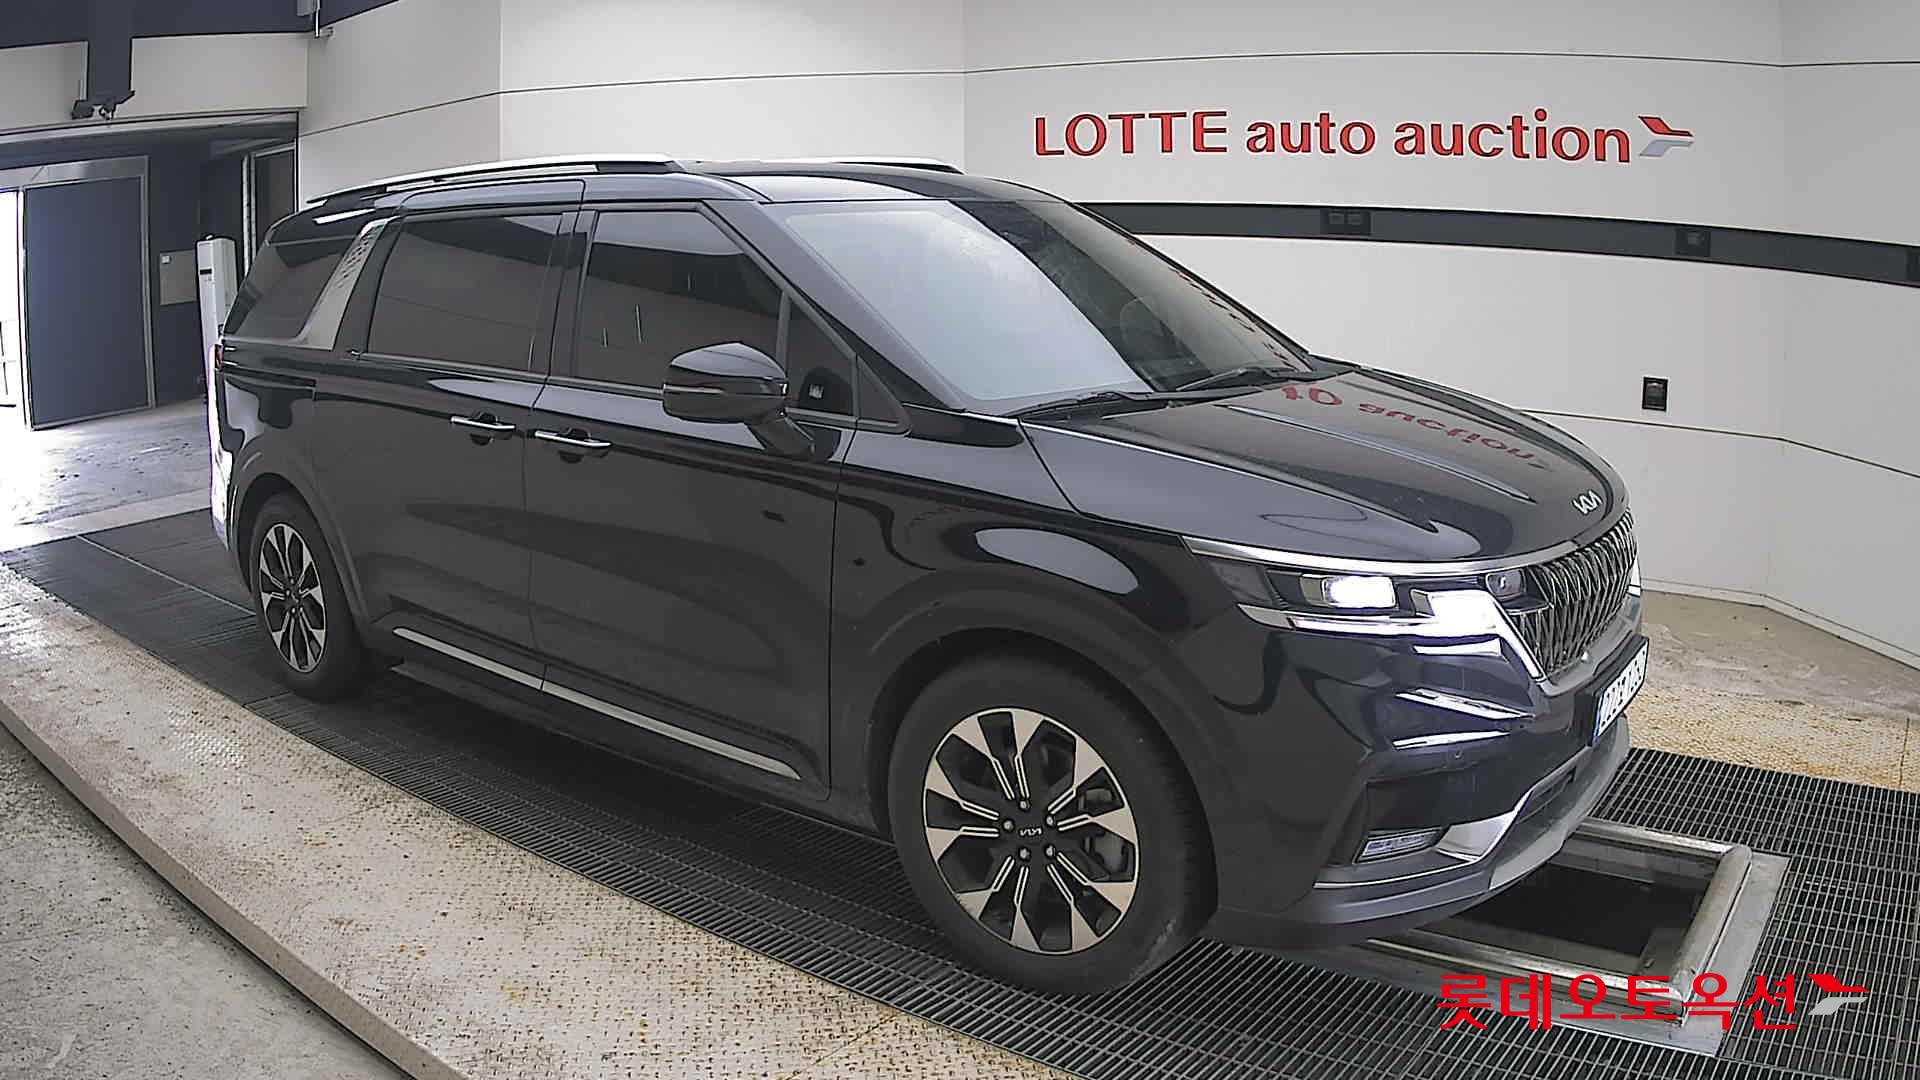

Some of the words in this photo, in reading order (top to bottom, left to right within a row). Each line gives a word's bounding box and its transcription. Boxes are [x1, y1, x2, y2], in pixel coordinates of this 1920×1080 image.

[1036, 110, 1228, 156] LOTTE
[1246, 114, 1377, 156] auto
[1394, 108, 1632, 163] auction
